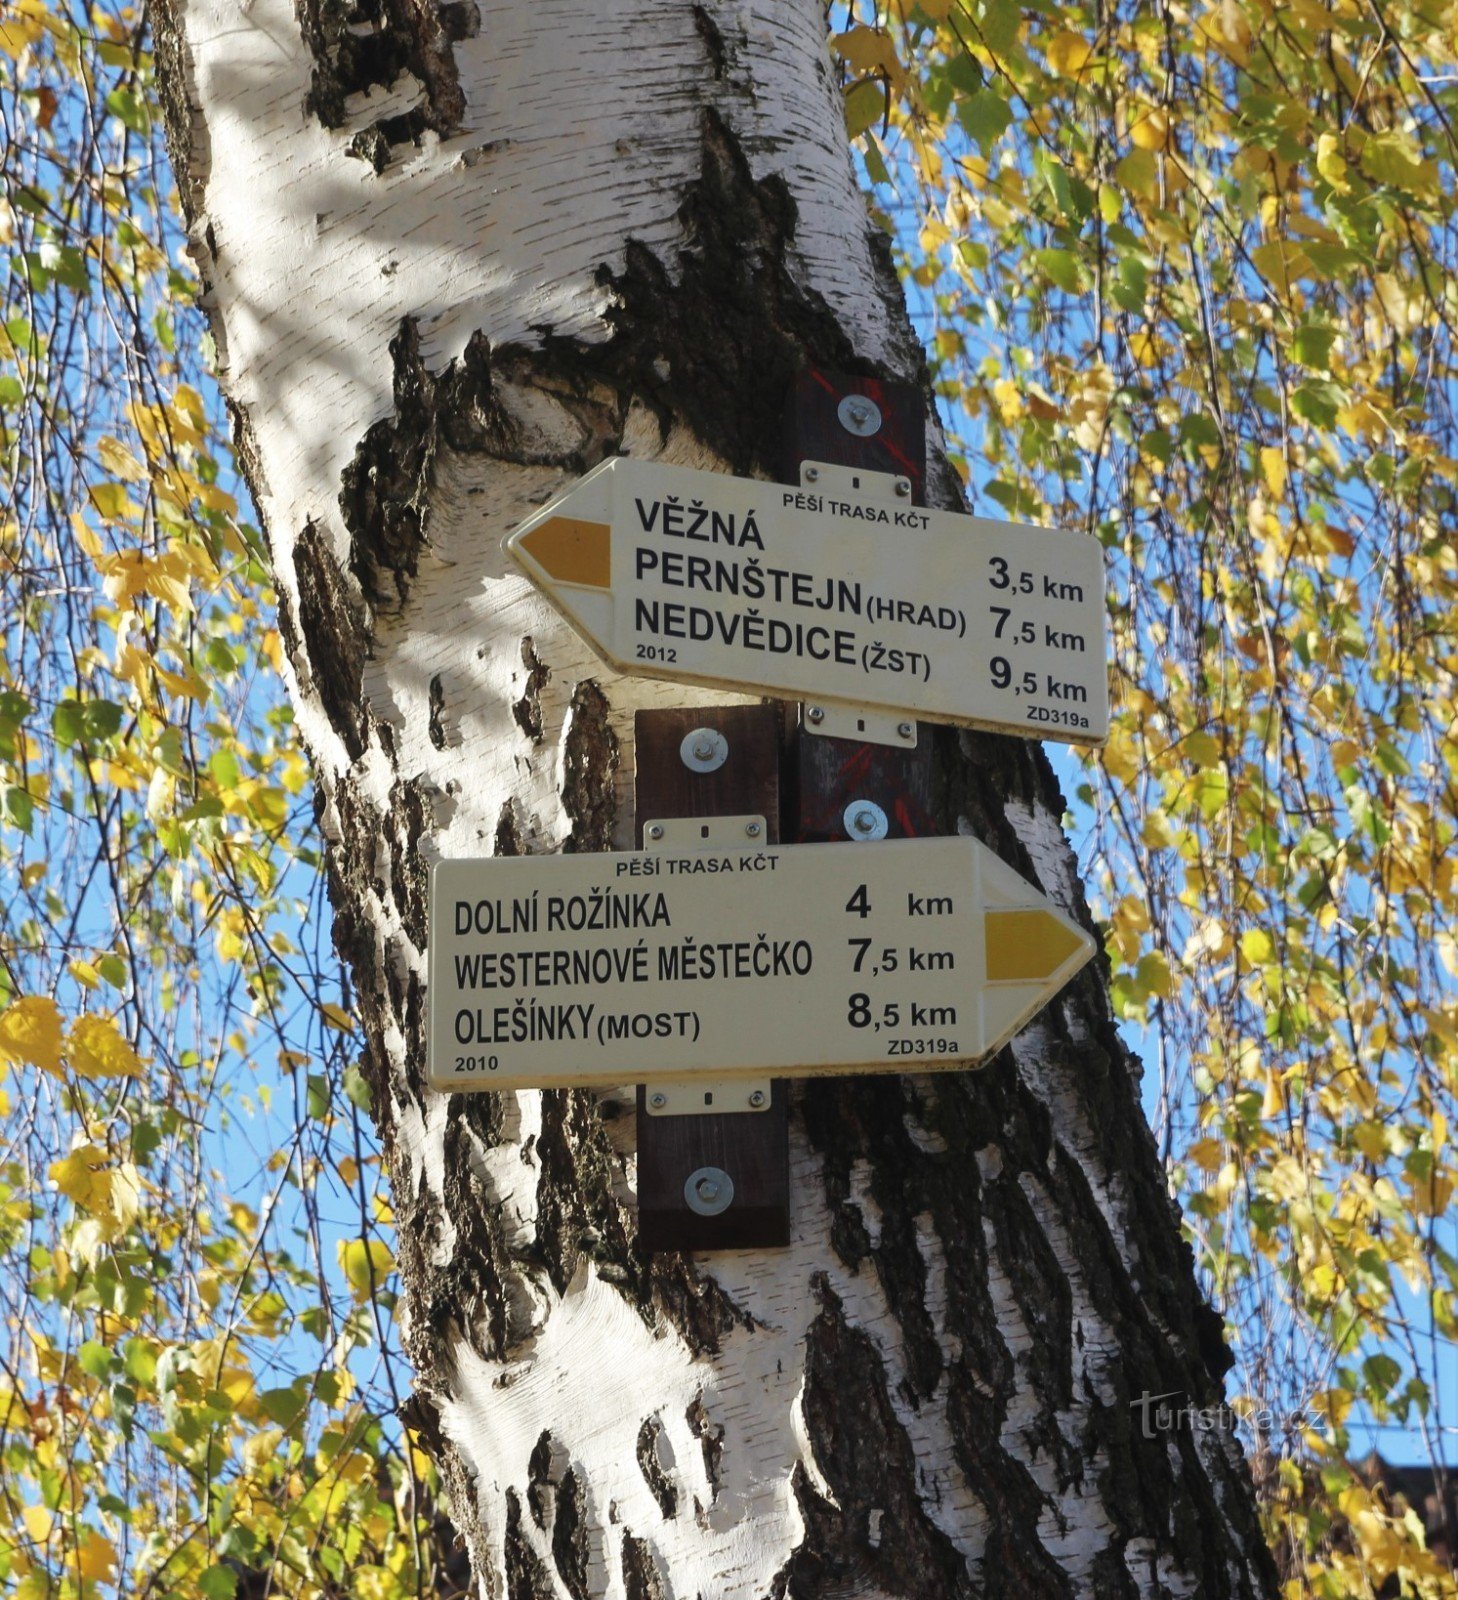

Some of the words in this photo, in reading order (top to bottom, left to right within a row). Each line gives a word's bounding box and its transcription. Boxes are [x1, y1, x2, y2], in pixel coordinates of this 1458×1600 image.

[782, 493, 824, 515] PĚŠÍ
[828, 501, 889, 524] TRASA
[894, 510, 930, 531] KČT
[634, 496, 766, 551] VĚŽNÁ
[988, 556, 1035, 596] 3,5
[1043, 574, 1084, 603] km
[635, 546, 862, 616] PERNŠTEJN
[866, 595, 967, 639] (HRAD)
[989, 605, 1036, 646] 7,5
[1045, 624, 1086, 653] km
[635, 597, 857, 666] NEDVĚDICE
[861, 644, 931, 683] (ŽST)
[989, 655, 1038, 697] 9,5
[1047, 674, 1088, 703] km
[636, 643, 678, 665] 2012
[1026, 705, 1090, 730] ZD319a
[615, 856, 661, 878] PĚŠÍ
[665, 857, 734, 876] TRASA
[738, 855, 780, 874] KČT
[455, 889, 539, 936] DOLNÍ
[547, 886, 672, 932] ROŽÍNKA
[845, 883, 872, 919] 4
[907, 892, 954, 917] km
[454, 938, 649, 990] WESTERNOVÉ
[658, 933, 813, 982] MĚSTEČKO
[847, 937, 899, 978] 7,5
[909, 947, 955, 972] km
[454, 997, 596, 1045] OLEŠÍNKY
[597, 1011, 700, 1046] (MOST)
[847, 992, 900, 1033] 8,5
[910, 1002, 957, 1027] km
[454, 1056, 499, 1072] 2010
[887, 1038, 959, 1056] ZD319a
